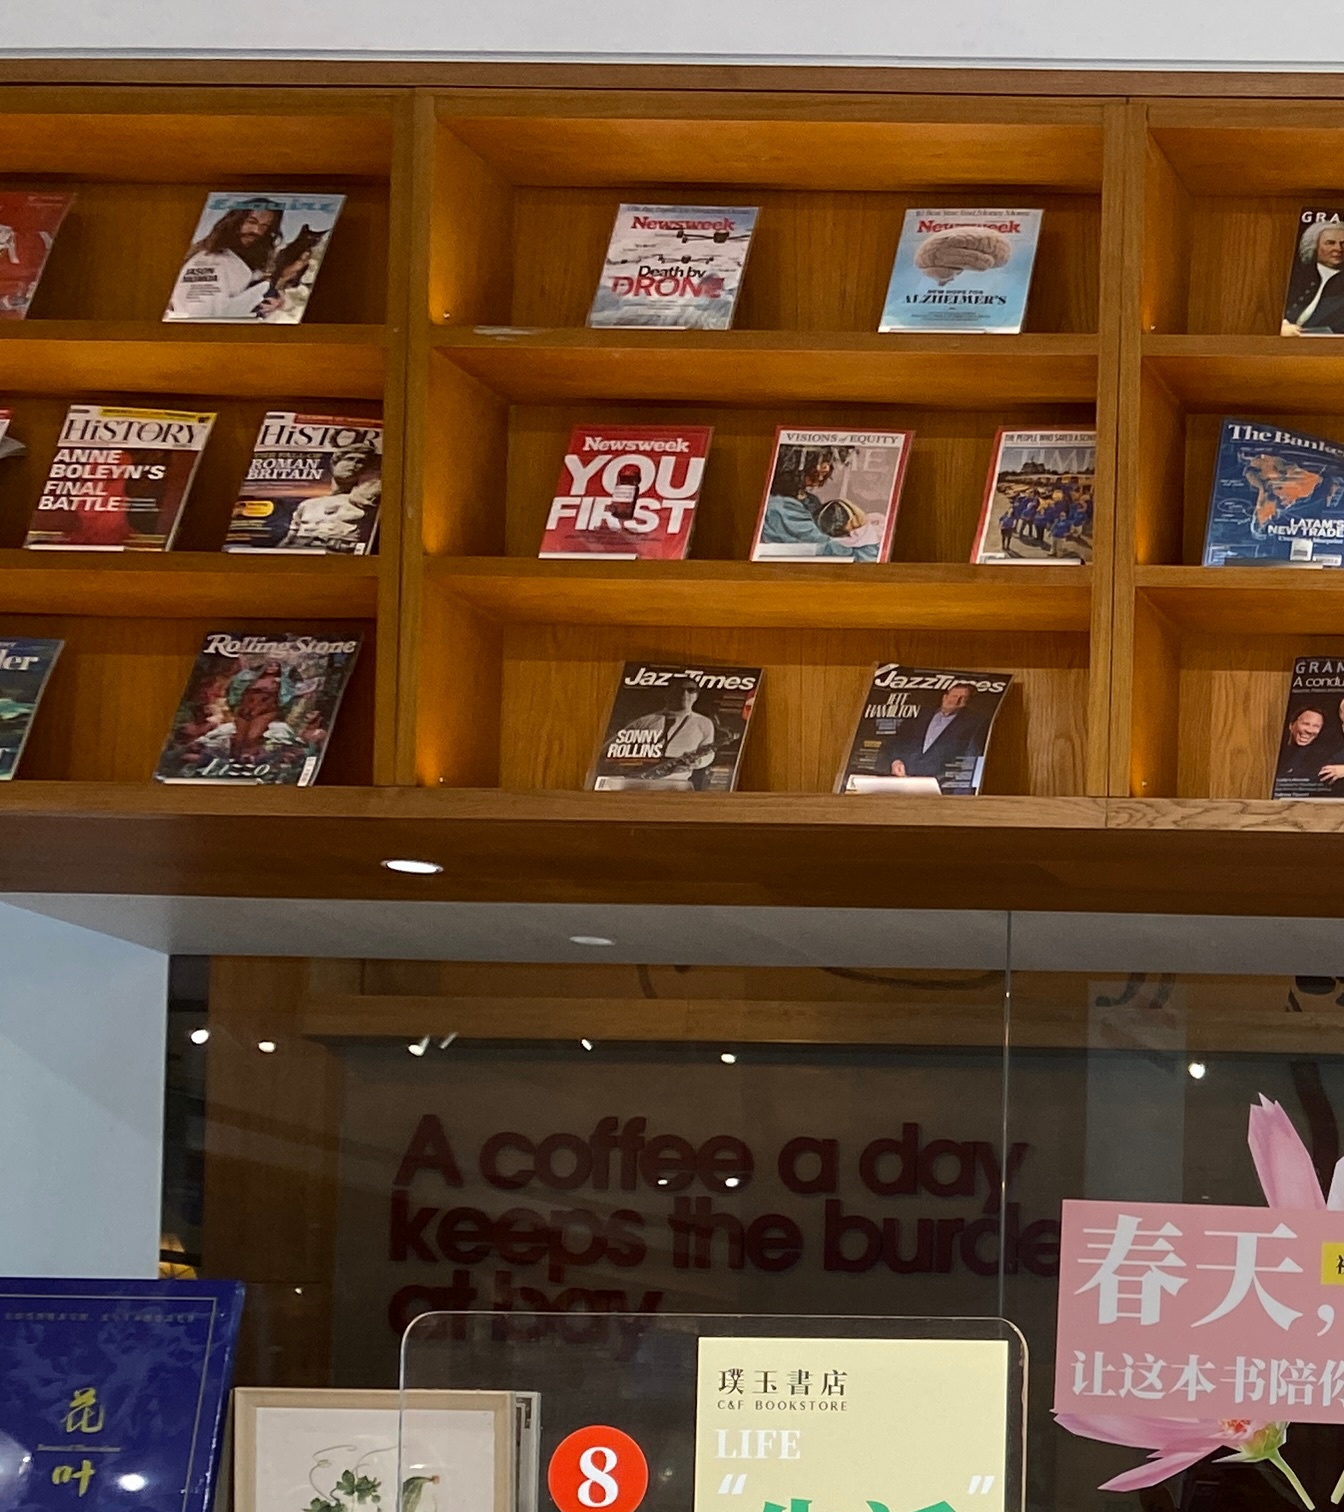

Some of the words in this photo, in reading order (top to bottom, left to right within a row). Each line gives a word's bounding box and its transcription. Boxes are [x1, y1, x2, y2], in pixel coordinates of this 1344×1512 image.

[631, 214, 735, 233] Newsweek
[638, 265, 682, 279] Death
[685, 266, 706, 281] by
[1228, 424, 1270, 443] The
[582, 436, 690, 453] Newsweek
[54, 449, 121, 465] ANNE
[251, 457, 322, 471] ROMAN
[49, 464, 166, 480] BOLEYN'S
[246, 467, 324, 481] BRITAIN
[563, 455, 705, 499] YOU
[43, 480, 107, 496] FINAL
[38, 494, 122, 513] BATTLE
[546, 497, 695, 535] FIRST
[1293, 676, 1303, 687] A
[615, 729, 663, 745] SONNY
[606, 742, 663, 759] ROLLINS
[394, 1113, 464, 1190] A
[479, 1117, 755, 1195] coffee
[778, 1136, 836, 1196] a
[859, 1122, 1029, 1215] day
[388, 1191, 649, 1283] keeps
[670, 1196, 801, 1274] the
[1074, 1213, 1339, 1338] 春天，
[717, 1368, 849, 1398] 璞玉書店
[717, 1400, 746, 1412] C&F
[755, 1400, 849, 1412] BOOKSTORE
[715, 1429, 802, 1461] LIFE
[576, 1446, 621, 1509] 8
